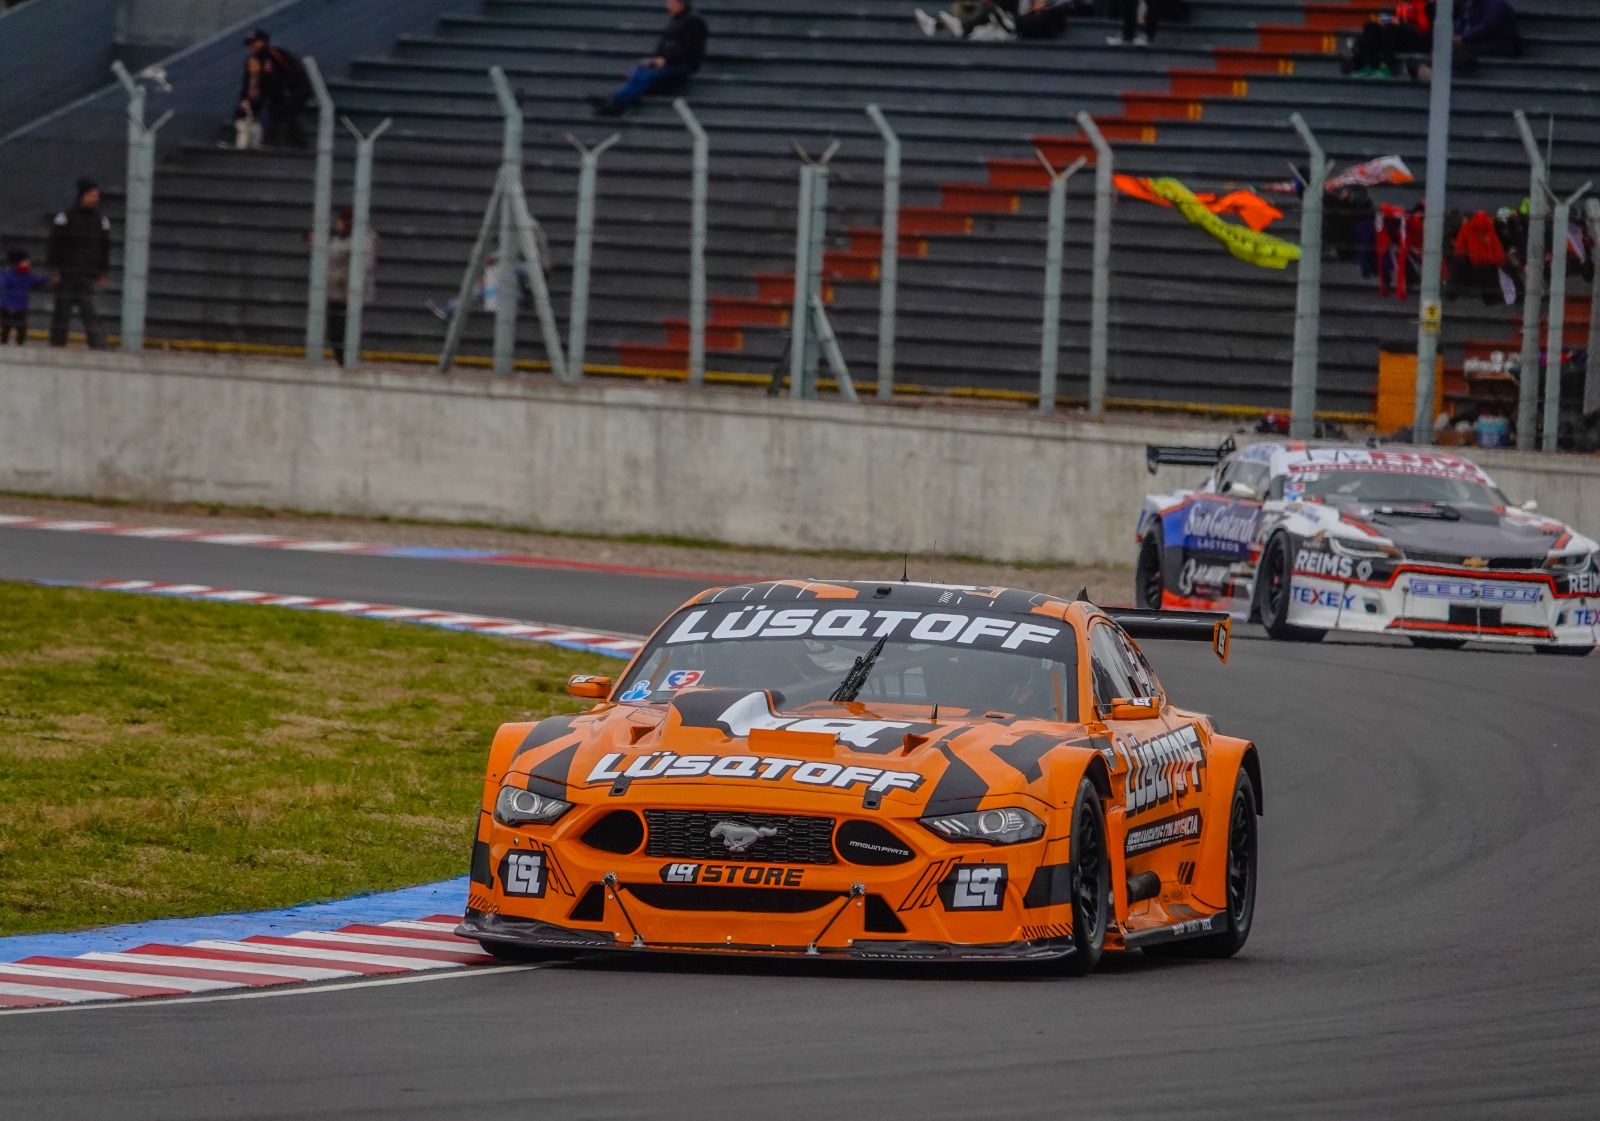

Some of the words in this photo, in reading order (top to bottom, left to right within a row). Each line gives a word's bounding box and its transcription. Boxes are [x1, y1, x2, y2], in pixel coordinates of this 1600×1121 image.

[1295, 549, 1353, 578] REIMS
[1292, 586, 1356, 609] TEXEY
[1413, 582, 1537, 600] GEDEON
[666, 604, 1061, 650] LÜSQTOFF
[586, 751, 923, 793] LÜSQTOFF
[702, 865, 804, 886] STORE
